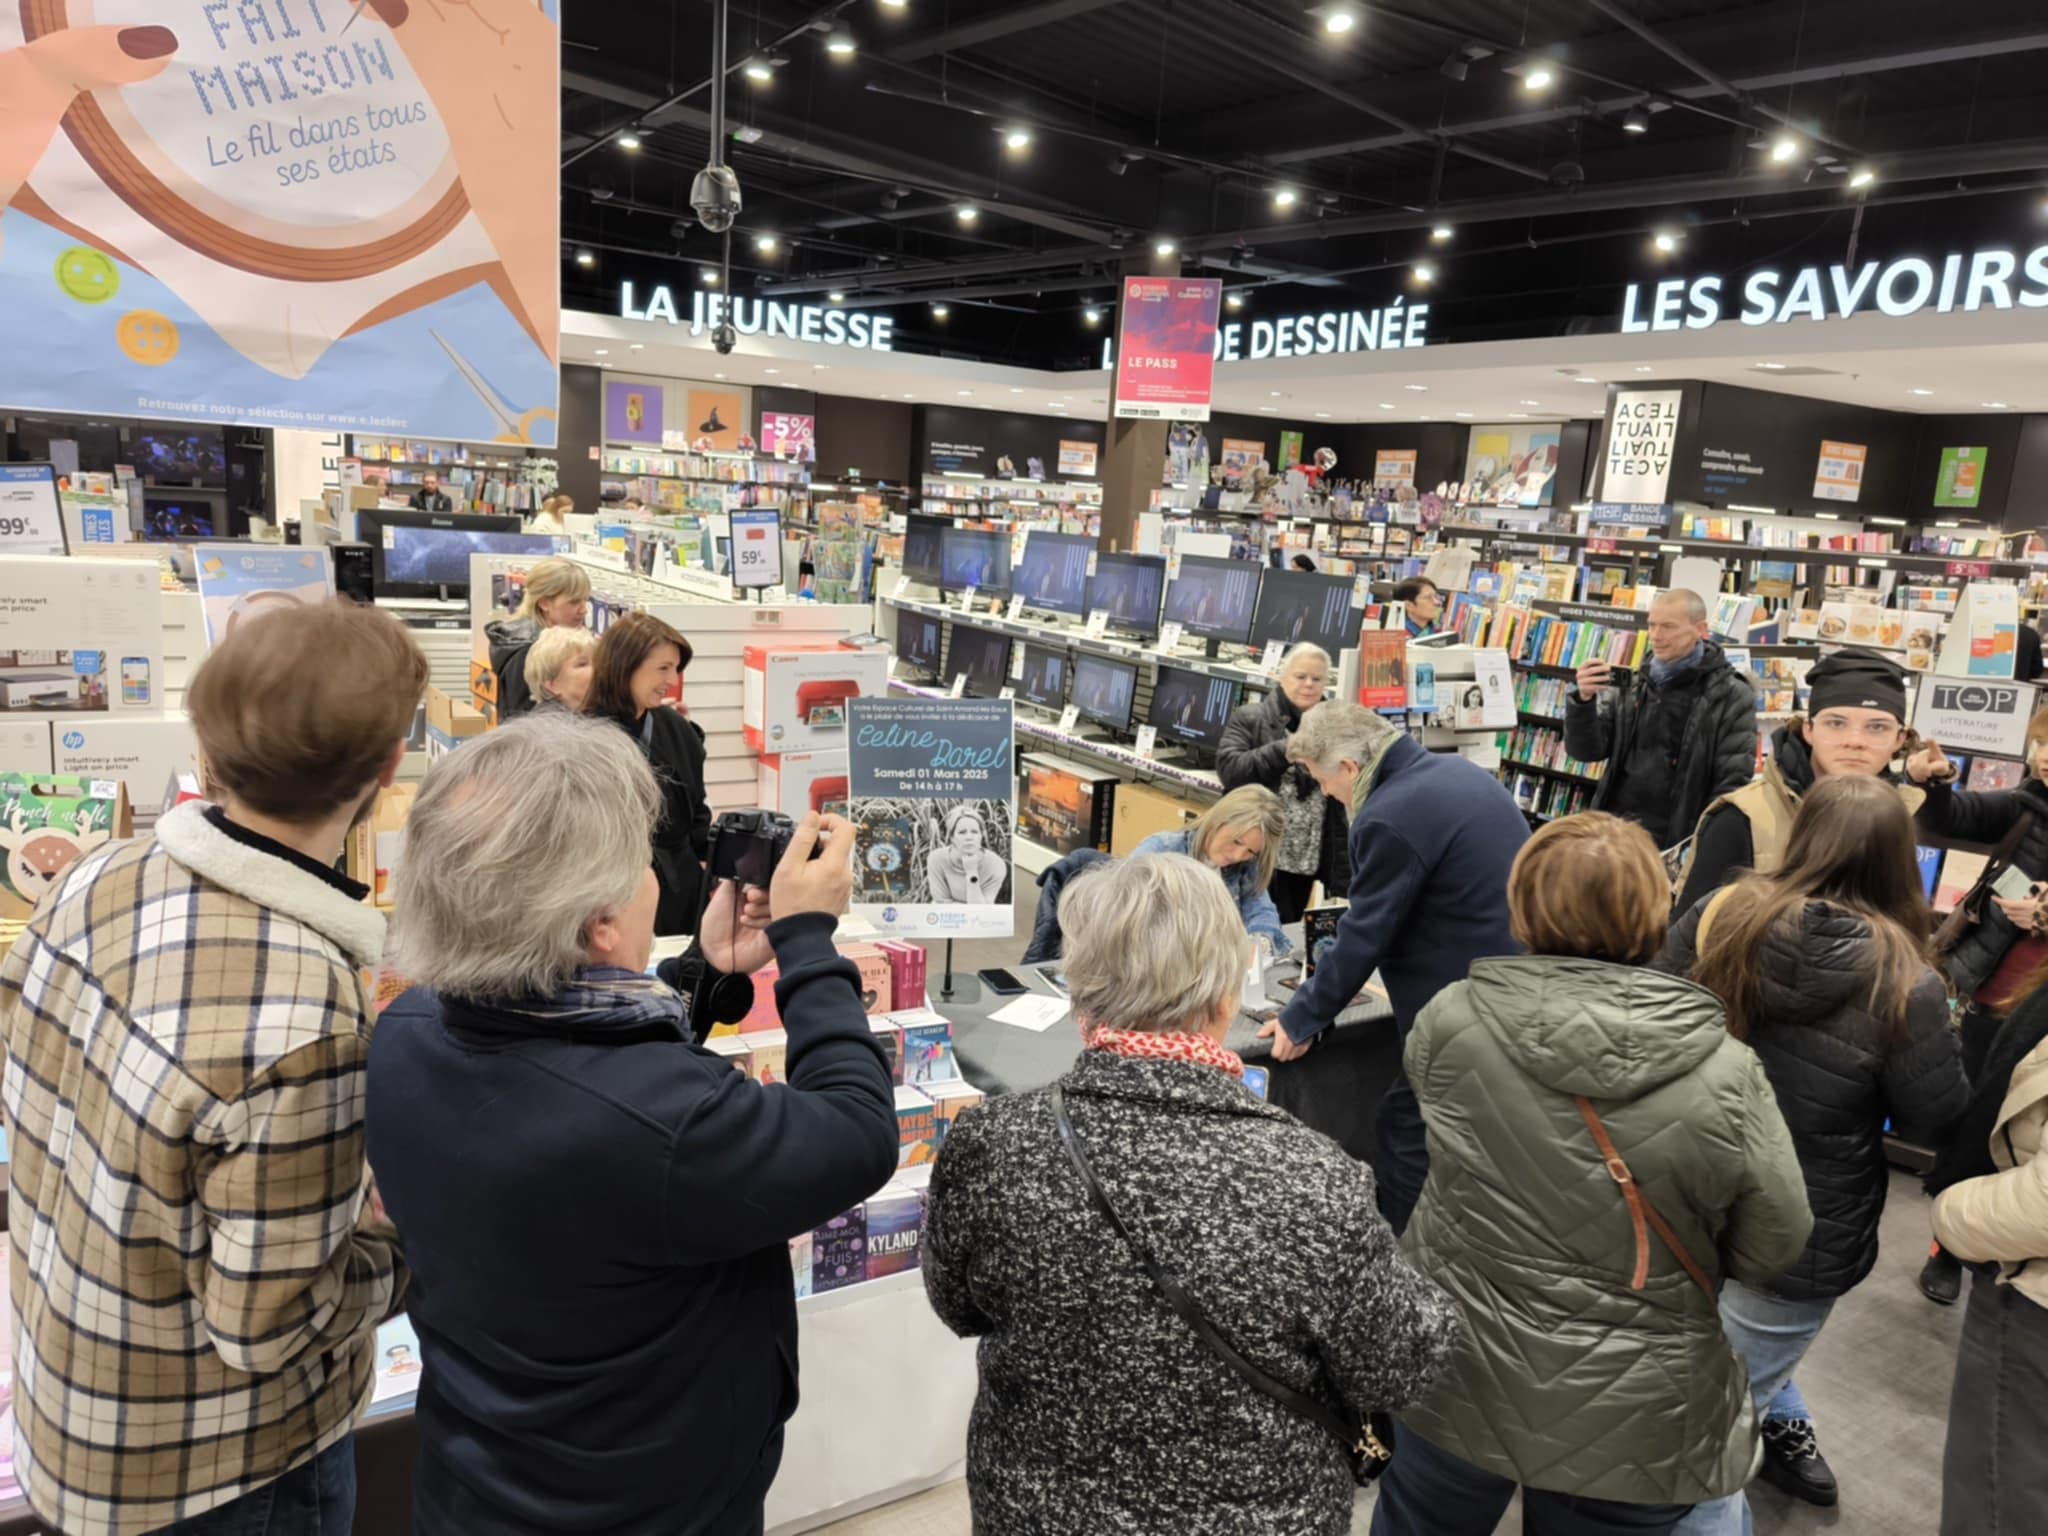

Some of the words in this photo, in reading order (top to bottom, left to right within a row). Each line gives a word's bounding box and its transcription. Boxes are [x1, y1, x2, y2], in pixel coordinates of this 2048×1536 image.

[189, 38, 394, 116] MAISON
[207, 136, 244, 167] Le
[248, 121, 282, 157] fil
[288, 116, 360, 148] dans
[366, 101, 427, 131] tous
[276, 160, 320, 186] ses
[328, 138, 396, 174] états
[621, 281, 679, 325] LA
[689, 291, 893, 351] JEUNESSE
[1621, 276, 1722, 334] LES
[1250, 295, 1429, 359] DESSINÉE
[1128, 357, 1142, 368] LE
[1146, 358, 1178, 369] PASS
[138, 397, 206, 413] Retrouvez
[209, 404, 245, 416] notre
[306, 412, 325, 421] sur
[764, 416, 811, 439] -5%
[771, 655, 799, 663] Canon
[1936, 685, 2013, 714] TOP
[64, 732, 84, 749] hp
[785, 754, 812, 762] Canon
[930, 738, 1008, 768] Darel
[874, 767, 915, 778] Samedi
[917, 769, 930, 778] 01
[933, 769, 960, 779] Mars
[963, 769, 989, 780] 2025
[899, 782, 912, 790] De
[935, 782, 942, 790] à
[945, 782, 955, 790] 17
[867, 1230, 918, 1254] KYLAND
[824, 1254, 853, 1268] FUIS
